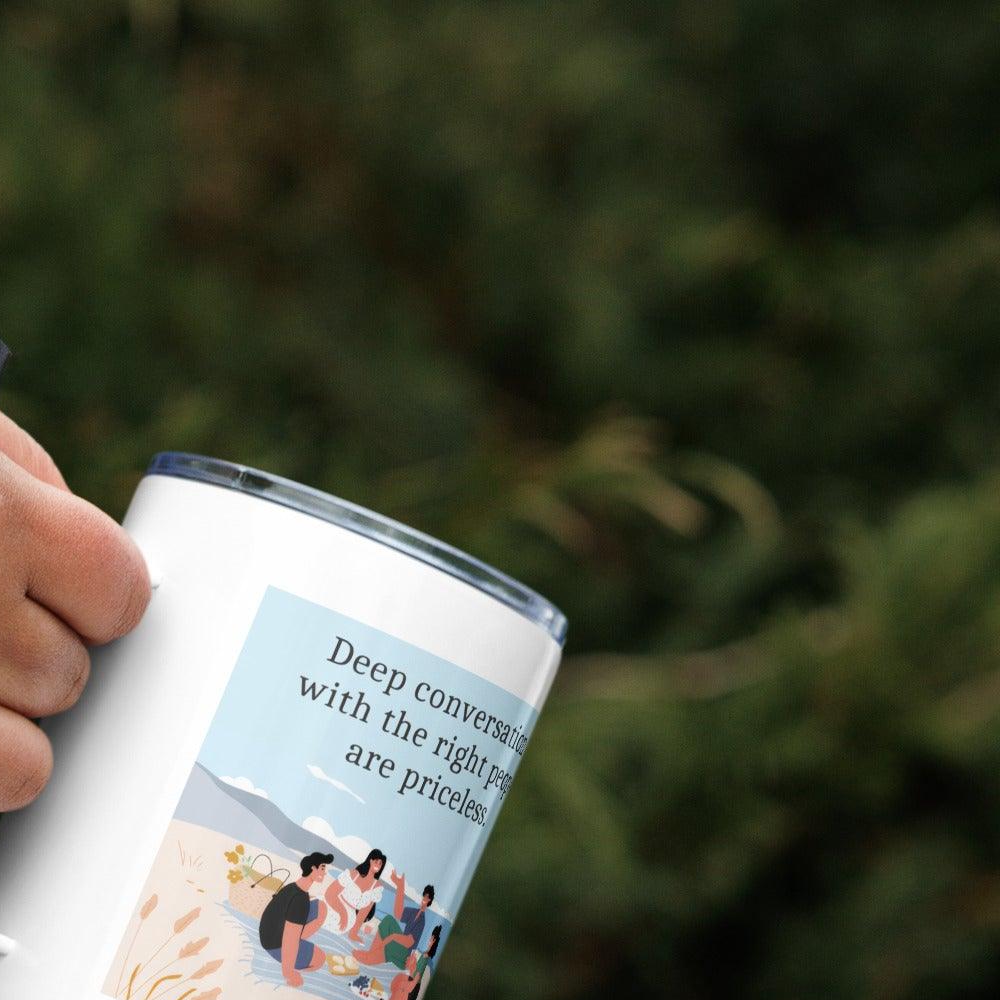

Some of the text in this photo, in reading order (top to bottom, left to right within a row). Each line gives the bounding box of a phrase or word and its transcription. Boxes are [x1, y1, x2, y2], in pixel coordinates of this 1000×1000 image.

[327, 636, 407, 695] Deep
[300, 675, 371, 723] with
[382, 710, 428, 747] the
[432, 736, 488, 775] right
[345, 743, 487, 827] are priceless.
